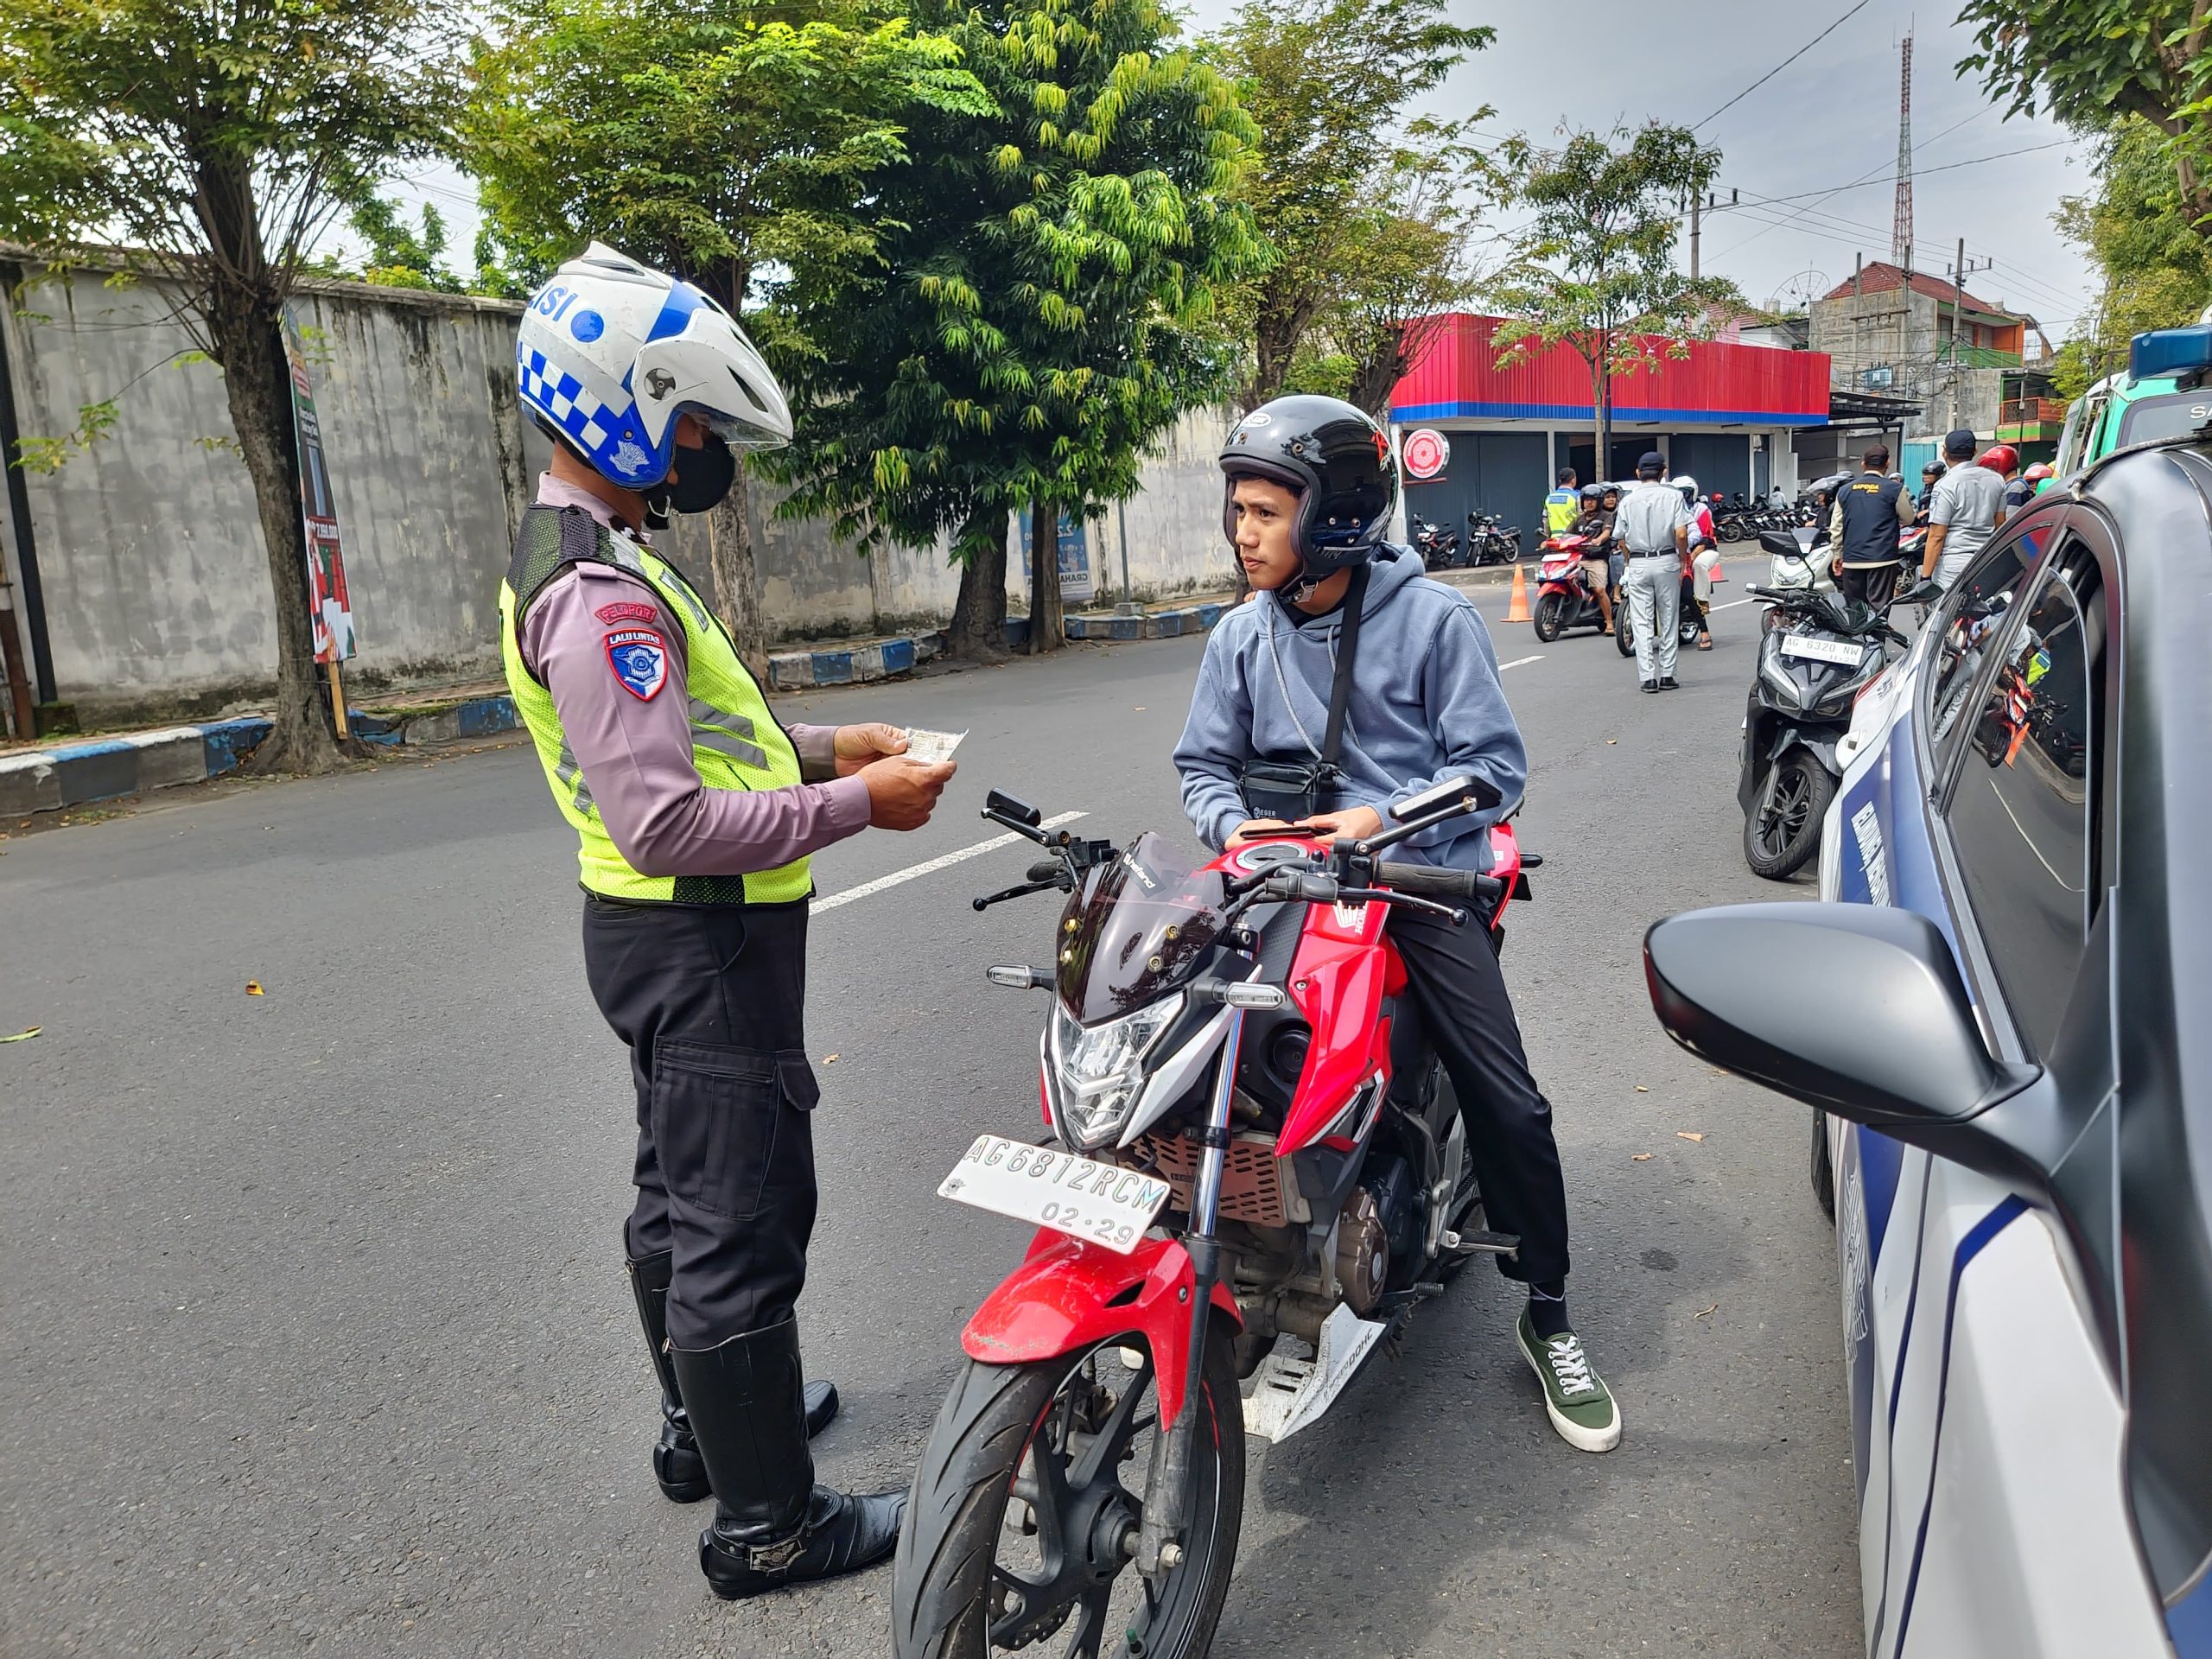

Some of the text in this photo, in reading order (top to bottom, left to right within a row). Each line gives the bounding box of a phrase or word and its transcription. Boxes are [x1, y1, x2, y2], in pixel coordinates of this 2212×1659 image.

[527, 283, 579, 322] ISI
[602, 605, 652, 621] PELOPOR
[609, 632, 661, 645] LALU LINTAS
[1786, 638, 1859, 656] AG 6320 NW
[1349, 1327, 1373, 1367] DOHC
